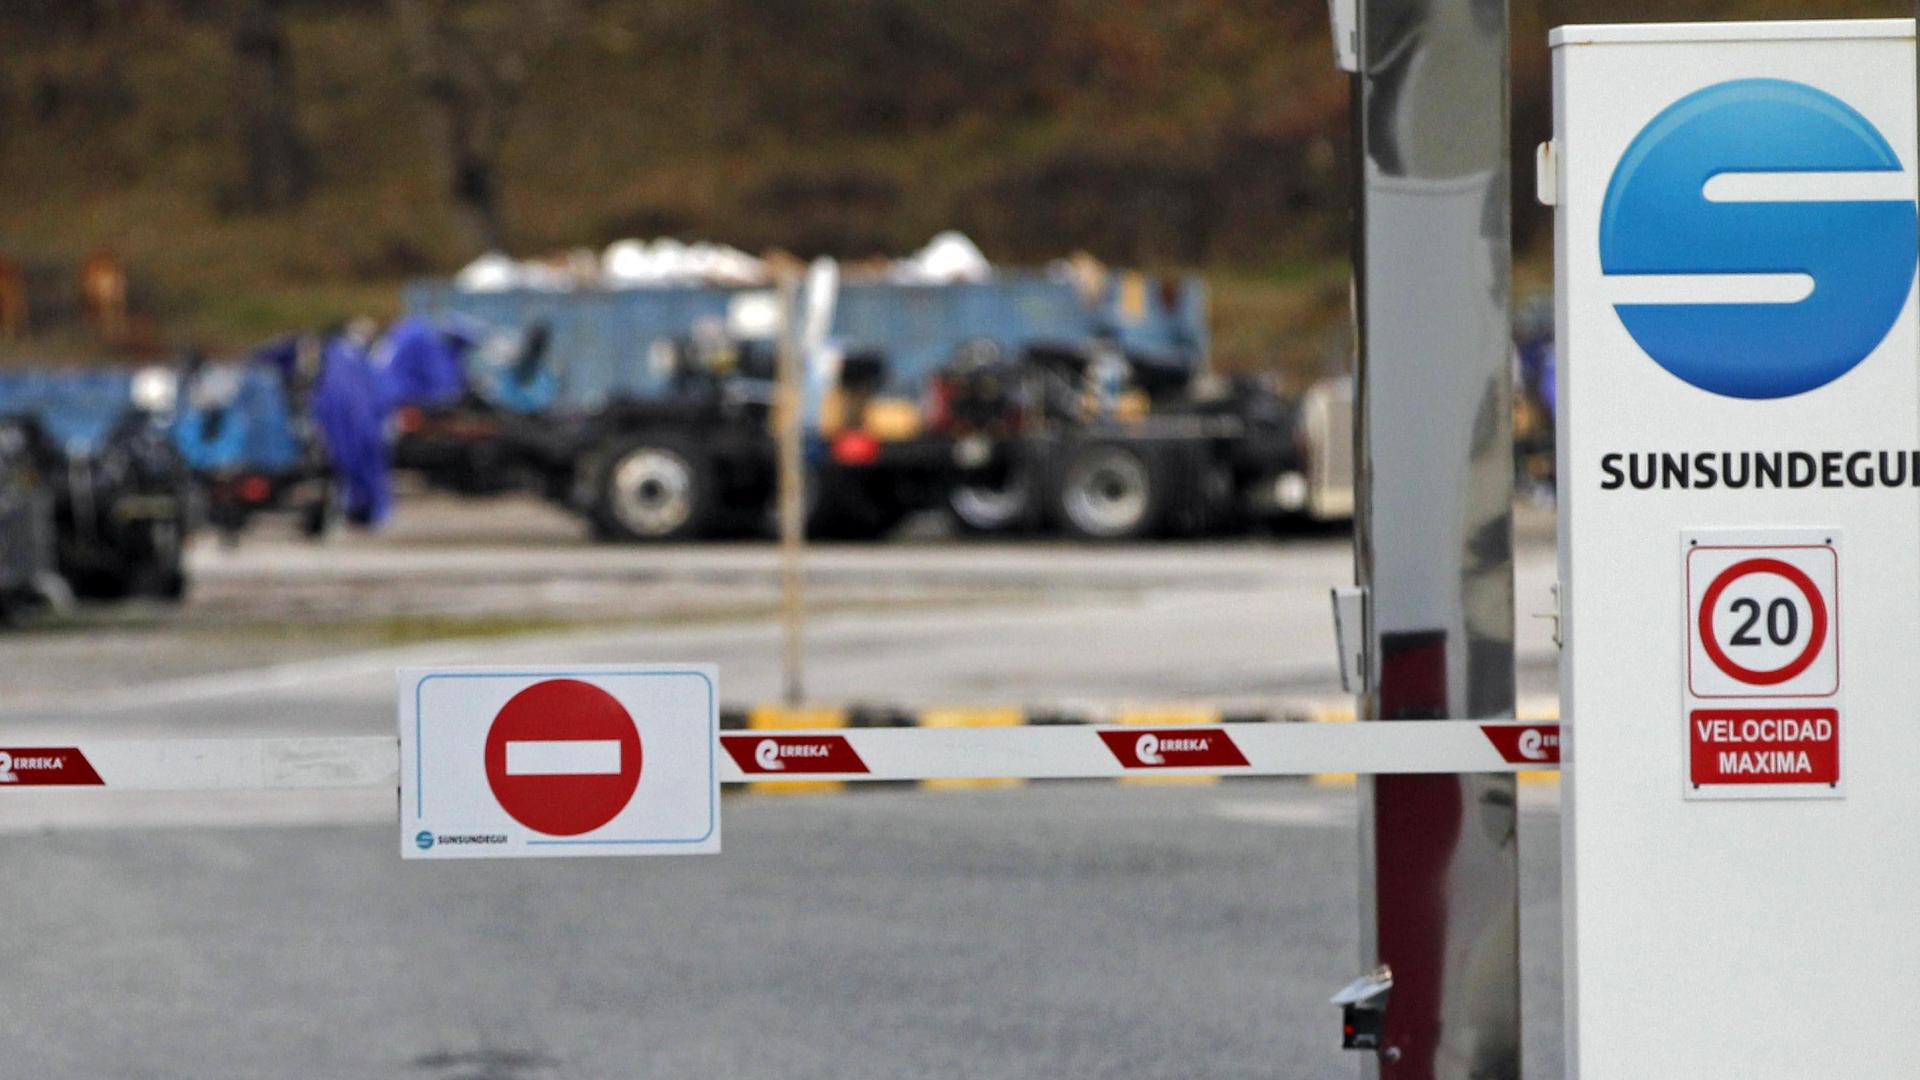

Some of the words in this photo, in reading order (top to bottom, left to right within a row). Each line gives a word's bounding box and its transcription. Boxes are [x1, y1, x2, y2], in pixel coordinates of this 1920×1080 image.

[1600, 450, 1920, 489] SUNSUNDEGUI
[1729, 597, 1798, 646] 20
[1697, 719, 1832, 742] VELOCIDAD
[780, 744, 829, 757] ERREKA
[1160, 738, 1208, 751] ERREKA
[13, 757, 63, 769] ERREKA
[1719, 752, 1812, 774] MAXIMA
